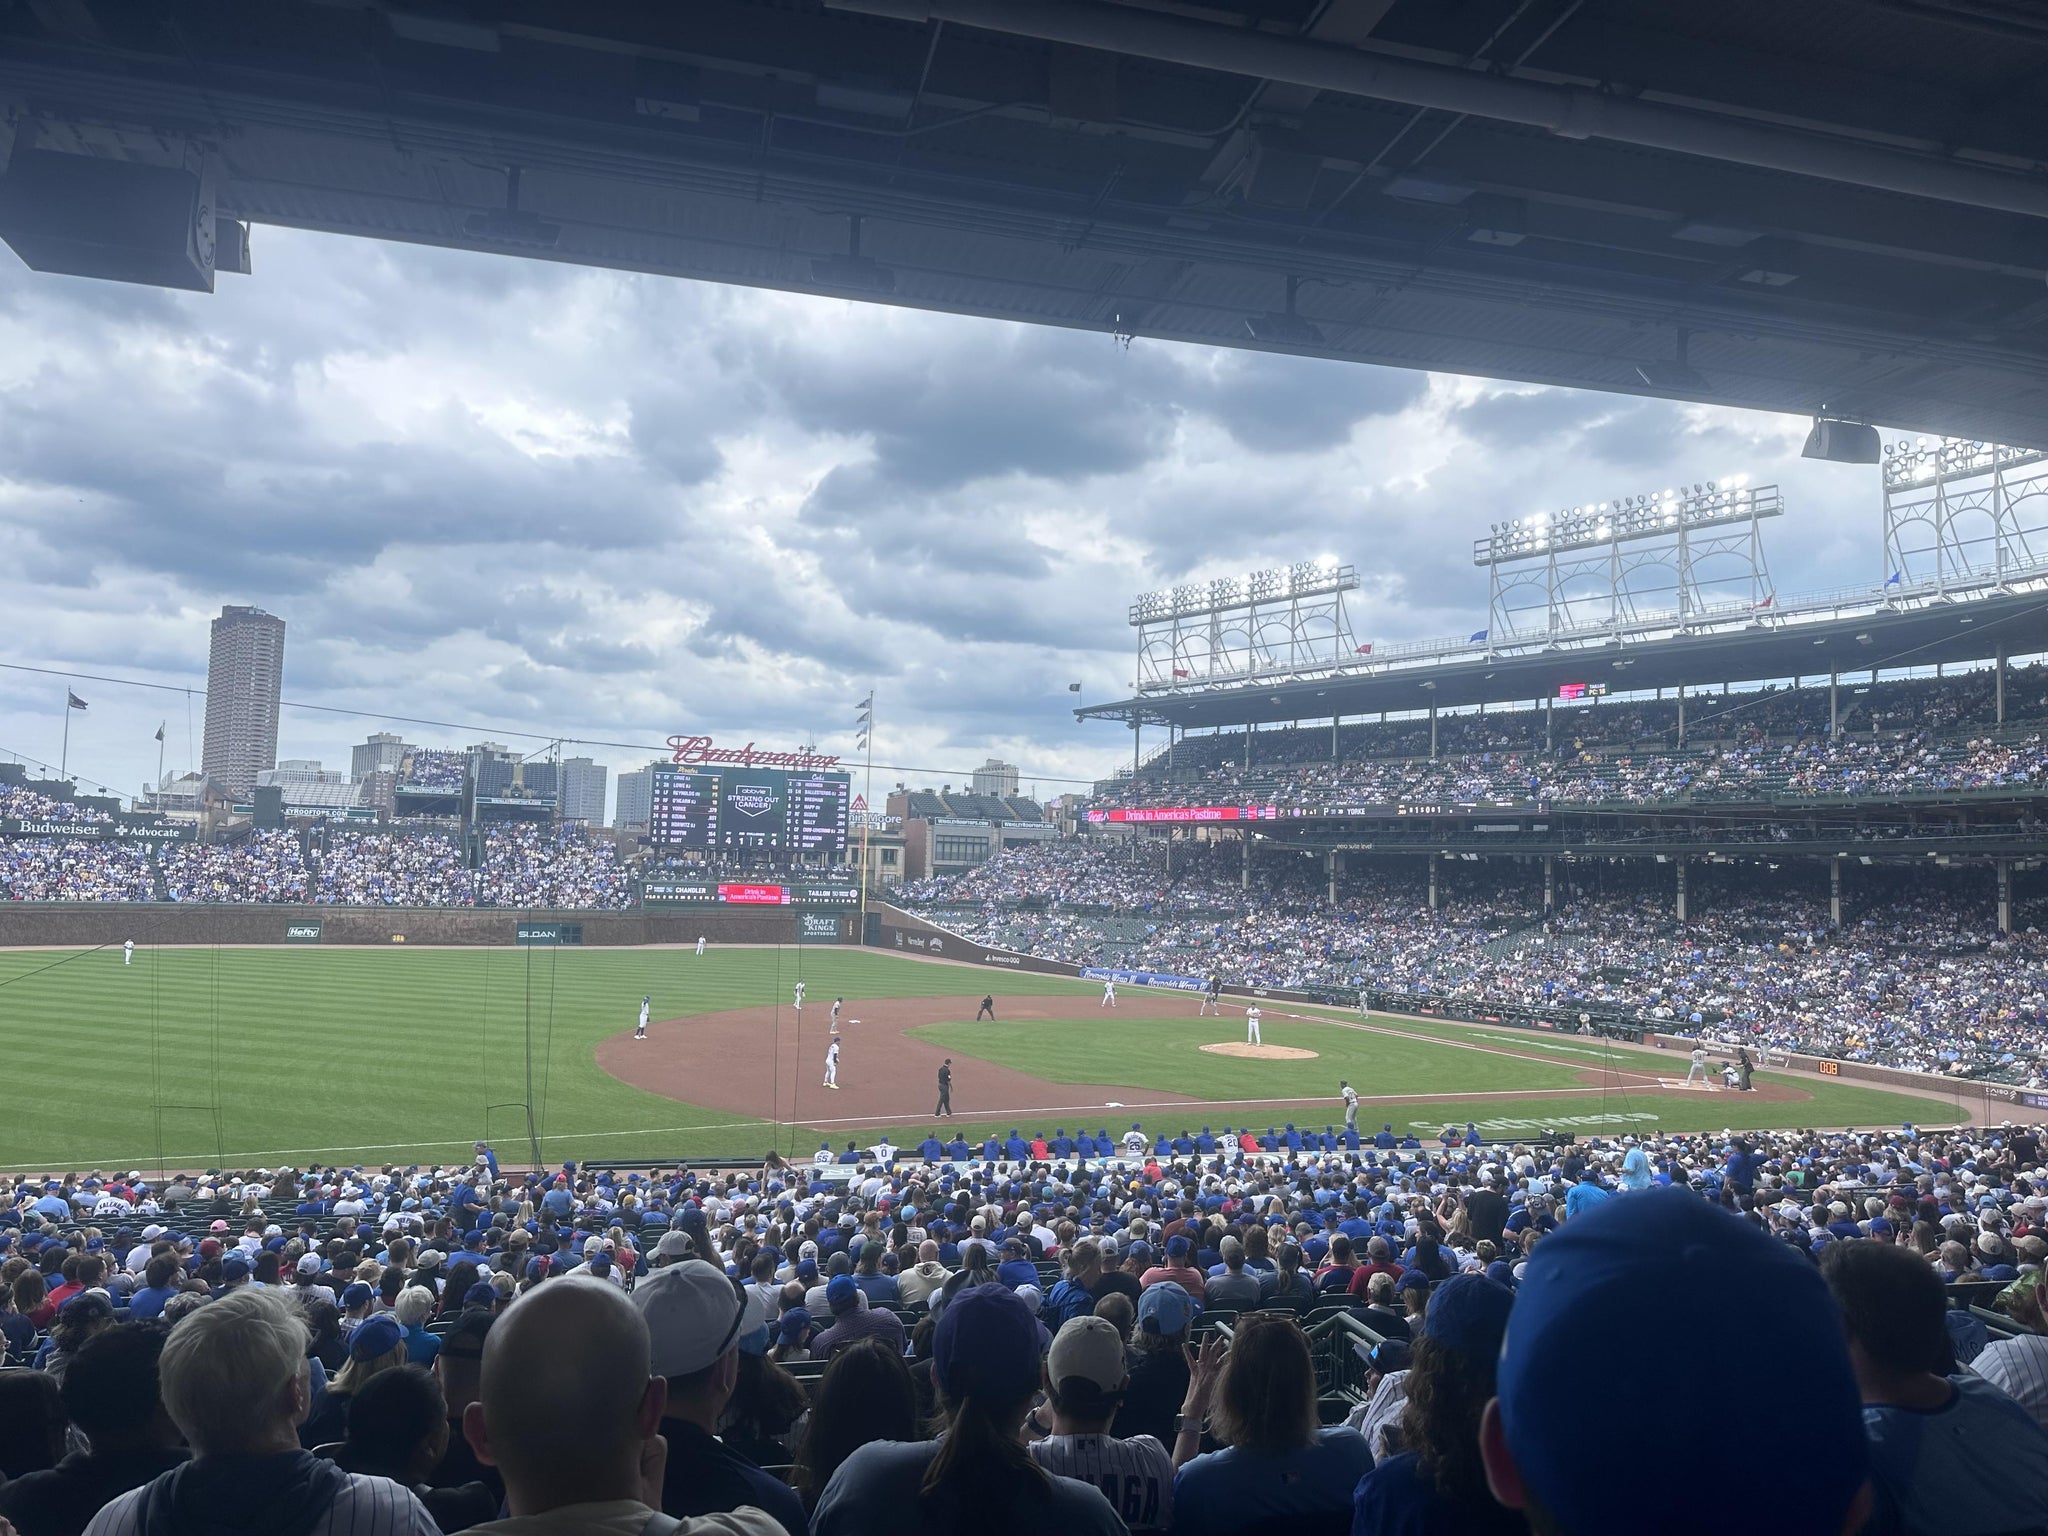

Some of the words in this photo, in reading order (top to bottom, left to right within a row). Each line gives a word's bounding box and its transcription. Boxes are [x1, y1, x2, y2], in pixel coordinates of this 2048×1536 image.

[666, 735, 840, 768] Budweiser
[738, 801, 768, 809] CANCER
[868, 814, 902, 824] Moore
[1125, 812, 1145, 821] Drink
[1145, 811, 1154, 820] In
[1153, 810, 1191, 820] America's
[1191, 809, 1222, 819] Pastime
[130, 826, 180, 838] Advocate
[725, 836, 732, 845] 4
[739, 837, 744, 845] 1
[757, 838, 763, 846] 2
[770, 838, 777, 846] 4
[808, 889, 831, 897] TAILLON
[289, 928, 317, 938] Hefty
[518, 930, 556, 938] SLOAN
[991, 954, 1009, 963] Invesco
[1009, 956, 1020, 964] QQQ
[1083, 969, 1112, 981] Reynolds
[1111, 972, 1128, 983] Wrap
[1147, 977, 1179, 988] Reynolds
[1178, 980, 1198, 991] Wrap
[1129, 1141, 1141, 1151] 25
[881, 1148, 887, 1158] 0
